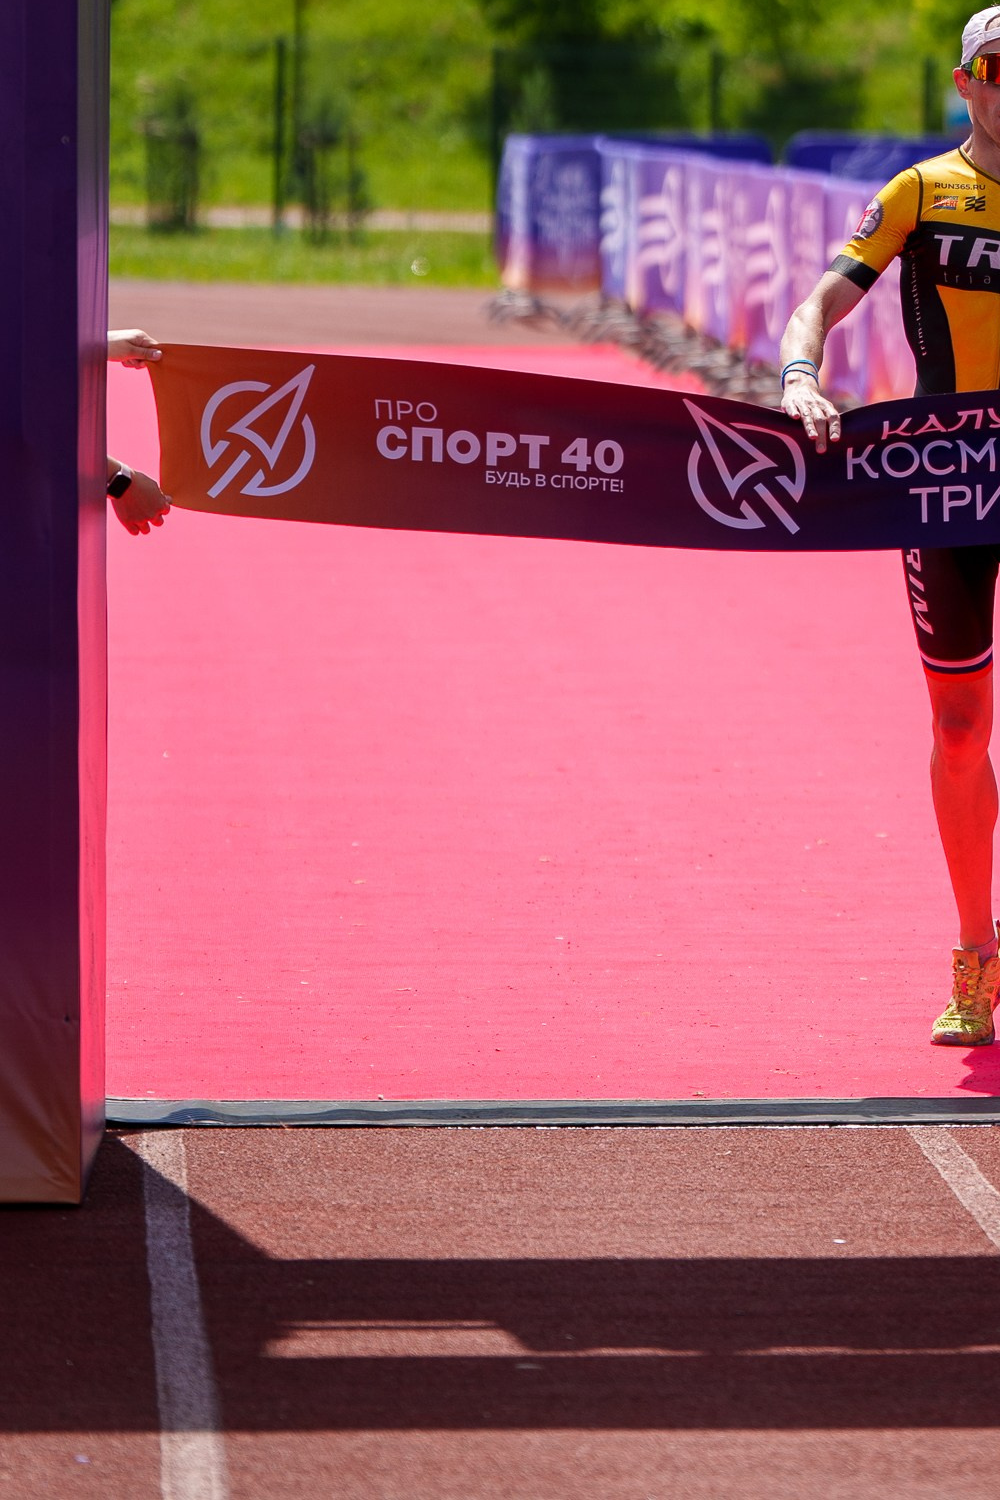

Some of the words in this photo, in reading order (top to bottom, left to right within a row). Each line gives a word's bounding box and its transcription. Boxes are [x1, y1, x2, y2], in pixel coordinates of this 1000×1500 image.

[934, 182, 986, 191] RUN365.RU
[374, 399, 438, 423] ПРО
[376, 425, 550, 470] СПОРТ
[561, 437, 625, 475] 40
[485, 471, 531, 488] БУДЬ
[535, 474, 547, 488] В
[550, 474, 625, 493] СПОРТЕ!
[907, 549, 934, 635] RIM
